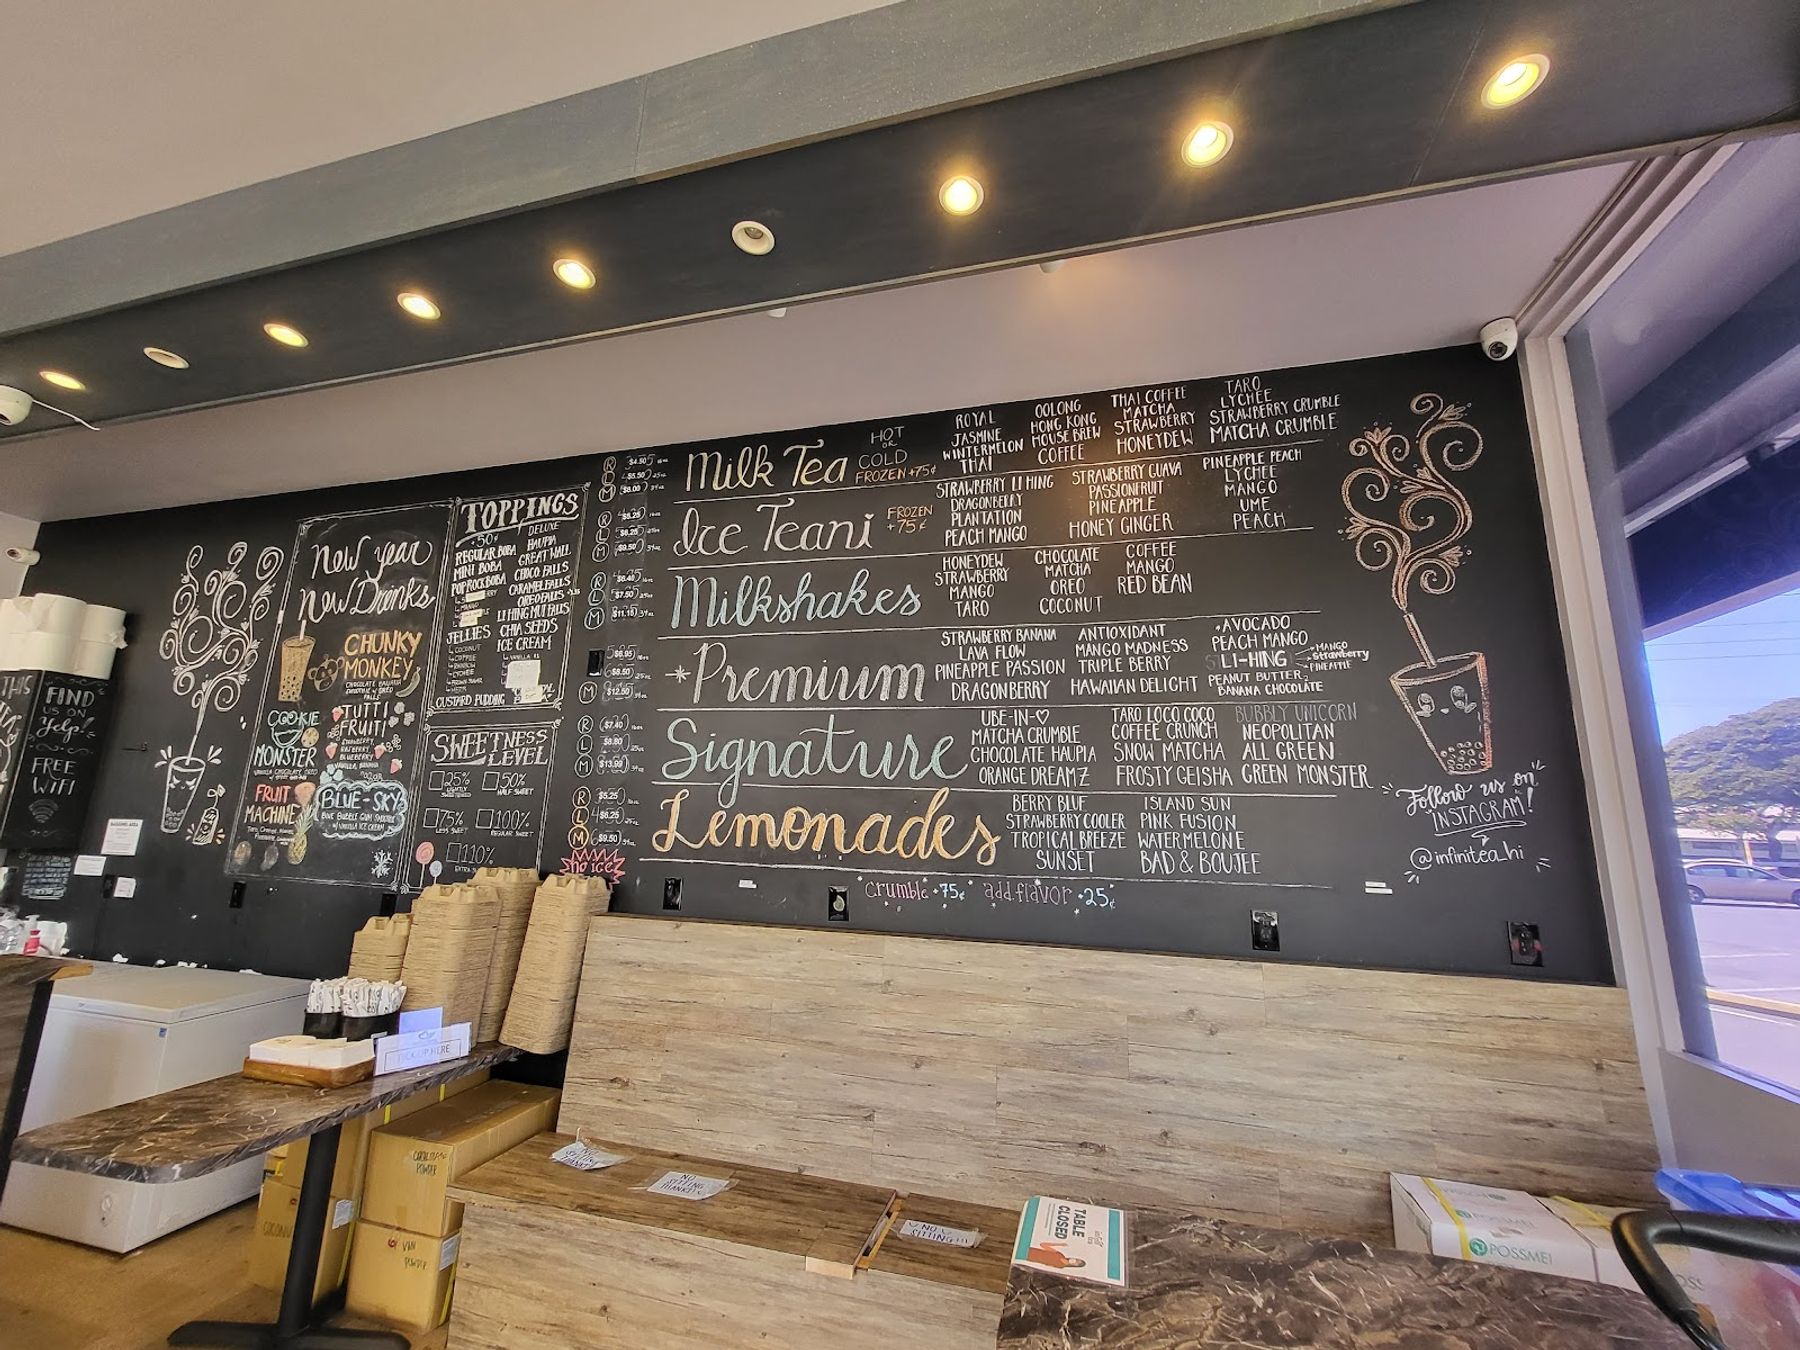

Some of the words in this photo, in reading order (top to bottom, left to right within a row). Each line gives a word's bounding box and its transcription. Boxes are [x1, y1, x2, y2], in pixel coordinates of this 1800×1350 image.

[1111, 392, 1142, 409] THAI
[1146, 385, 1187, 403] COFFEE
[1220, 389, 1272, 409] LYCHEE
[1035, 399, 1081, 418] OOLONG
[955, 410, 996, 429] ROYAL
[1210, 421, 1269, 444] MATCHA
[1276, 412, 1338, 435] CRUMBLE
[1031, 431, 1069, 448] HOUSE
[1072, 426, 1101, 441] BREW
[1117, 428, 1194, 455] HONEYDEW
[858, 449, 907, 469] COLD
[943, 438, 1024, 461] WINTERMELON
[686, 445, 774, 491] Milk
[783, 439, 848, 487] Tea
[1071, 464, 1145, 485] STRAWBERRY
[1149, 461, 1182, 478] GUAVA
[1225, 465, 1277, 482] LYCHEE
[936, 477, 1005, 499] STRAWBERRY
[1012, 476, 1022, 492] LI
[1026, 474, 1054, 490] HING
[461, 493, 578, 533] TOPPINGS
[1089, 497, 1157, 516] PINEAPPLE
[1239, 497, 1270, 512] UME
[673, 508, 748, 556] Ice
[756, 498, 874, 551] Teani
[951, 509, 1021, 527] PLANTATION
[528, 521, 560, 536] DELUXE
[527, 535, 556, 550] HAUPIA
[455, 548, 496, 567] REGULAR
[498, 545, 517, 557] BOBA
[518, 550, 549, 566] GREAT
[550, 545, 571, 559] WALL
[942, 553, 1003, 571] HONEYDEW
[1035, 547, 1100, 565] CHOCOLATE
[453, 566, 474, 581] MINI
[479, 561, 502, 575] BOBA
[515, 567, 541, 581] CHOCO
[542, 561, 569, 576] FALLS
[1126, 558, 1175, 574] MANGO
[452, 583, 466, 597] POP
[466, 578, 486, 592] ROCK
[486, 573, 506, 587] BOBA
[509, 579, 546, 596] CARAMEL
[545, 575, 571, 590] FALLS
[949, 584, 995, 600] MANGO
[1050, 578, 1085, 595] OREO
[350, 577, 435, 615] Drinks
[517, 596, 538, 608] OREO
[538, 591, 565, 601] FALLS
[671, 569, 921, 629] Milkshakes
[507, 608, 528, 621] HING
[546, 602, 570, 616] FALLS
[447, 624, 491, 644] JELLIES
[500, 624, 522, 638] CHIA
[525, 618, 558, 634] SEEDS
[1078, 624, 1166, 641] ANTIOXIDANT
[1222, 615, 1290, 633] AVOCADO
[344, 630, 422, 657] CHUNKY
[497, 640, 513, 652] ICE
[516, 636, 551, 650] CREAM
[941, 630, 1012, 646] STRAWBERRY
[1016, 628, 1057, 642] BANANA
[344, 657, 413, 680] MONKEY
[1078, 658, 1123, 674] TRIPLE
[1129, 655, 1171, 672] BERRY
[1221, 650, 1287, 669] LI-HING
[693, 642, 925, 704] Premium
[935, 661, 1000, 681] PINEAPPLE
[1006, 659, 1065, 677] PASSION
[1208, 673, 1251, 687] PEANUT
[1256, 670, 1301, 681] BUTTER
[46, 687, 95, 707] FIND
[436, 695, 472, 707] CUSTARD
[67, 709, 86, 718] ON
[268, 710, 320, 727] COOKIE
[342, 701, 389, 718] TUTTI
[971, 727, 1024, 745] MATCHA
[1028, 725, 1080, 744] CRUMBLE
[1112, 723, 1161, 741] COFFEE
[1167, 722, 1218, 740] CRUNCH
[1242, 723, 1335, 740] NEOPOLITAN
[254, 745, 316, 767] MONSTER
[431, 730, 548, 762] SWEETNESS
[487, 746, 548, 766] LEVEL
[32, 757, 76, 780] FREE
[662, 714, 968, 808] Signature
[445, 772, 470, 786] 25%
[501, 772, 527, 788] 50%
[979, 767, 1026, 785] ORANGE
[1031, 766, 1090, 787] DREAMZ
[1116, 766, 1173, 787] FROSTY
[1176, 766, 1233, 786] GEISHA
[255, 784, 292, 803] FRUIT
[1013, 795, 1051, 812] BERRY
[1058, 795, 1088, 812] BLUE
[1144, 796, 1194, 811] ISLAND
[1201, 796, 1231, 811] SUN
[1396, 784, 1473, 816] Follow
[1480, 779, 1505, 796] us
[1512, 772, 1538, 787] on
[244, 804, 301, 825] MACHINE
[1432, 787, 1533, 832] INSTAGRAM!
[439, 811, 464, 827] 75%
[494, 811, 530, 829] 100%
[652, 786, 1002, 867] Lemonades
[1006, 814, 1081, 830] STRAWBERRY
[1083, 813, 1126, 829] COOLER
[1140, 813, 1173, 829] PINK
[1180, 814, 1237, 831] FUSION
[1011, 832, 1079, 849] TROPICAL
[1080, 832, 1126, 849] BREEZE
[462, 845, 495, 864] 110%
[1141, 850, 1175, 875] BAD
[1179, 851, 1194, 873] &
[1199, 852, 1261, 875] BOUJEE
[1410, 841, 1524, 870] @infinitea_hi
[865, 879, 929, 899] crumble
[921, 1224, 937, 1233] NO
[1057, 1205, 1071, 1239] CLOSED
[1072, 1210, 1086, 1238] TABLE
[1490, 1243, 1552, 1265] POSSMEI
